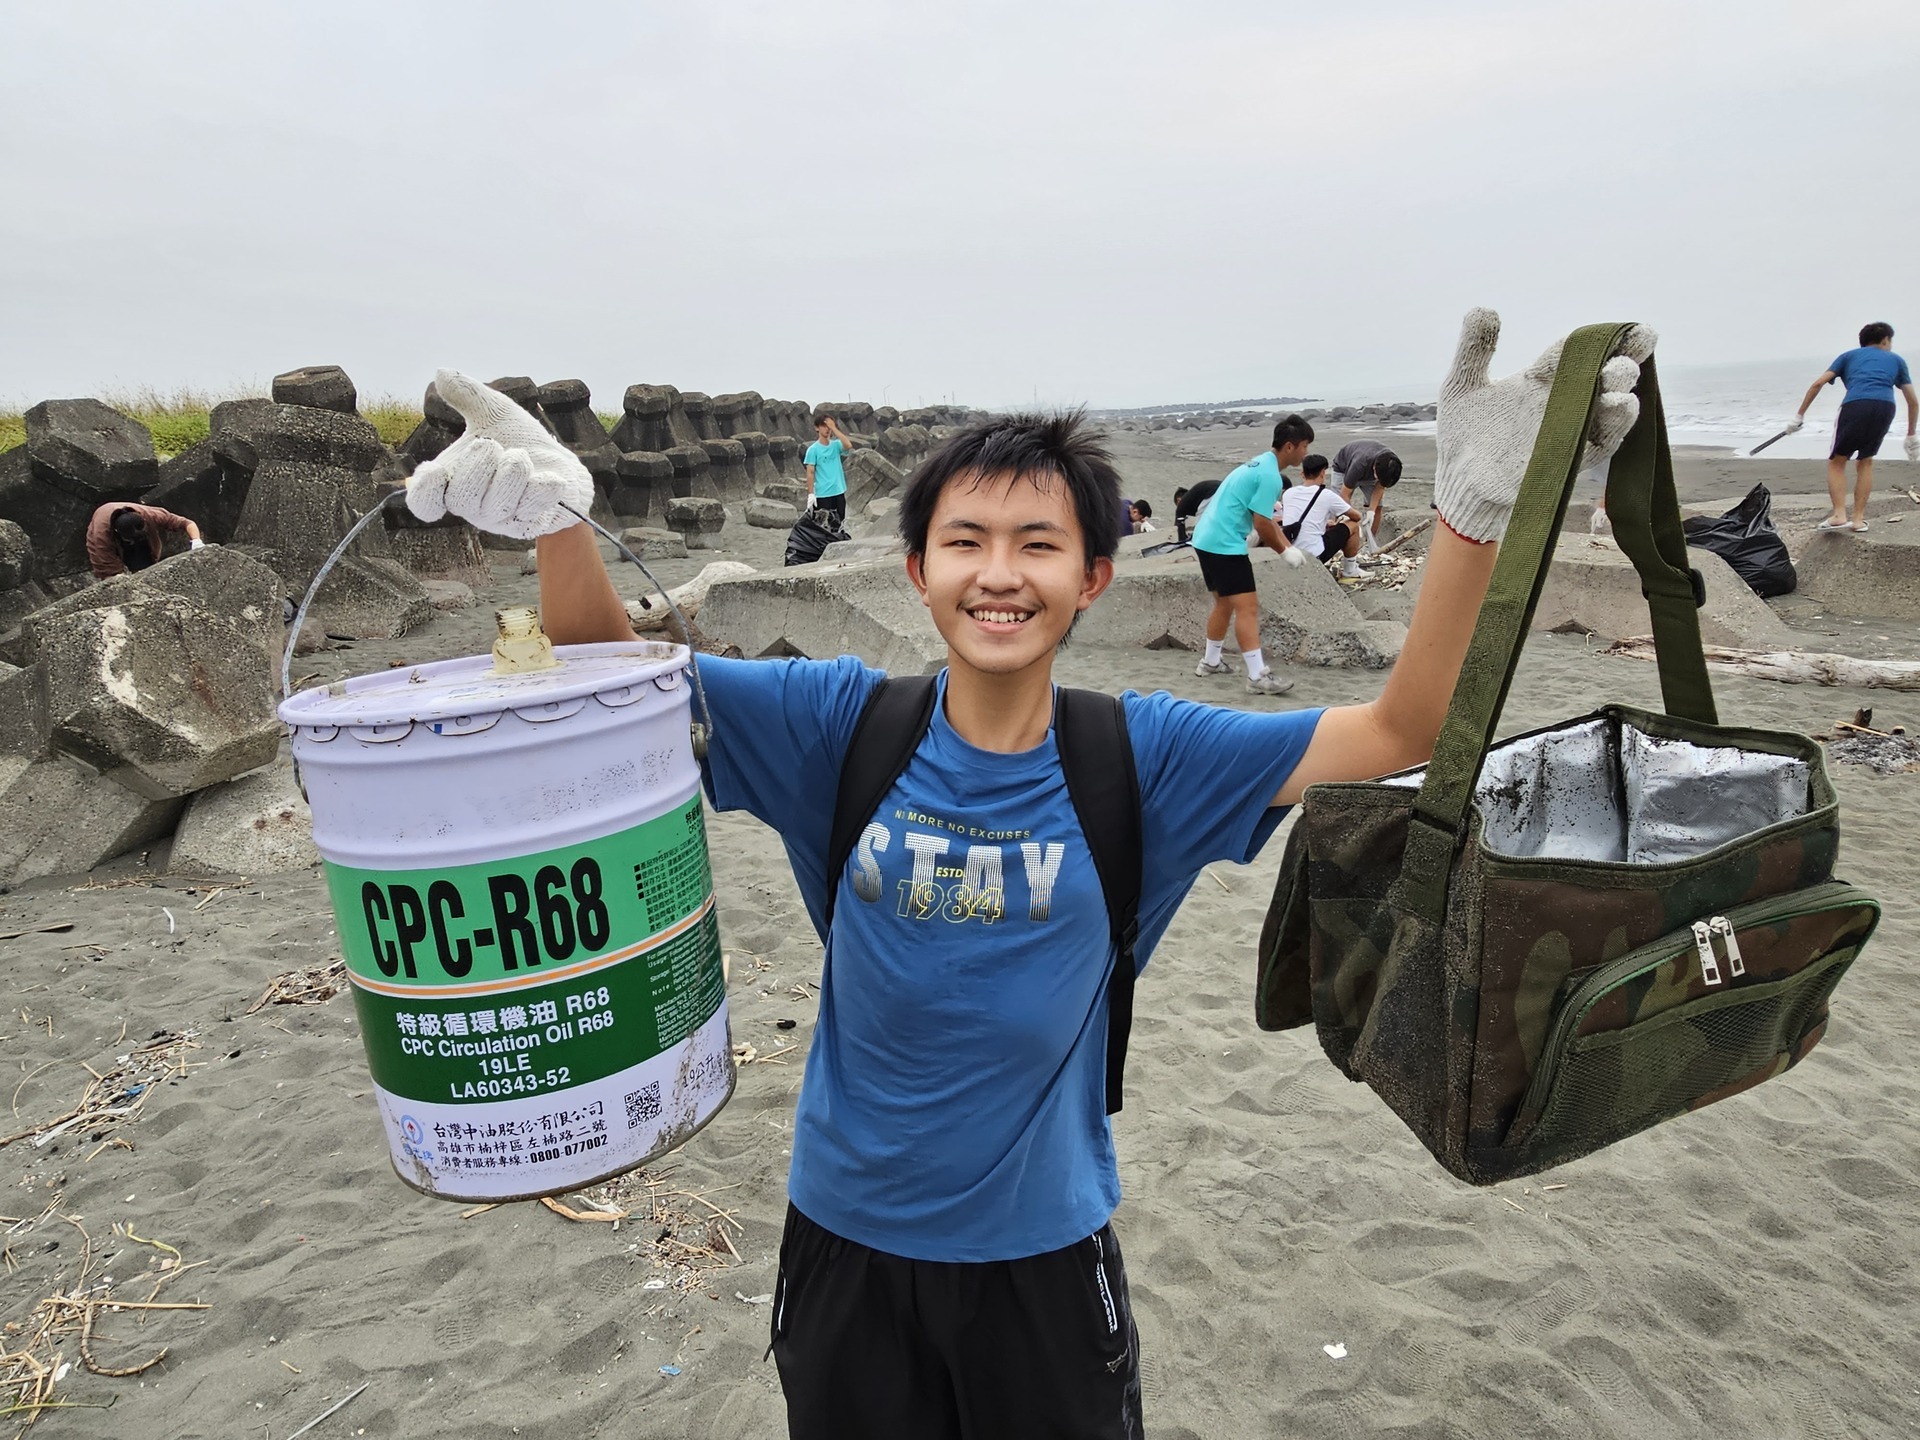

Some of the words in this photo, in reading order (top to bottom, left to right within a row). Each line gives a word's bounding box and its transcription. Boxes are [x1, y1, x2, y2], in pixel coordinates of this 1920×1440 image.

[908, 811, 944, 828] MORE
[948, 822, 965, 834] NO
[969, 828, 1030, 840] EXCUSES
[853, 821, 1065, 921] STAY
[361, 856, 610, 979] CPC-R68
[897, 879, 1002, 925] 1984
[396, 1000, 558, 1037] 特級循環機油
[565, 986, 611, 1016] R68
[401, 1037, 434, 1057] CPC
[439, 1033, 541, 1057] Circulation
[545, 1021, 573, 1043] Oil
[578, 1010, 614, 1035] R68
[450, 1066, 571, 1099] LA60343-52
[479, 1053, 532, 1076] 19LE
[433, 1100, 604, 1140] 台灣中油股份有限公司
[437, 1119, 608, 1154] 高雄市楠梓區左楠路二號
